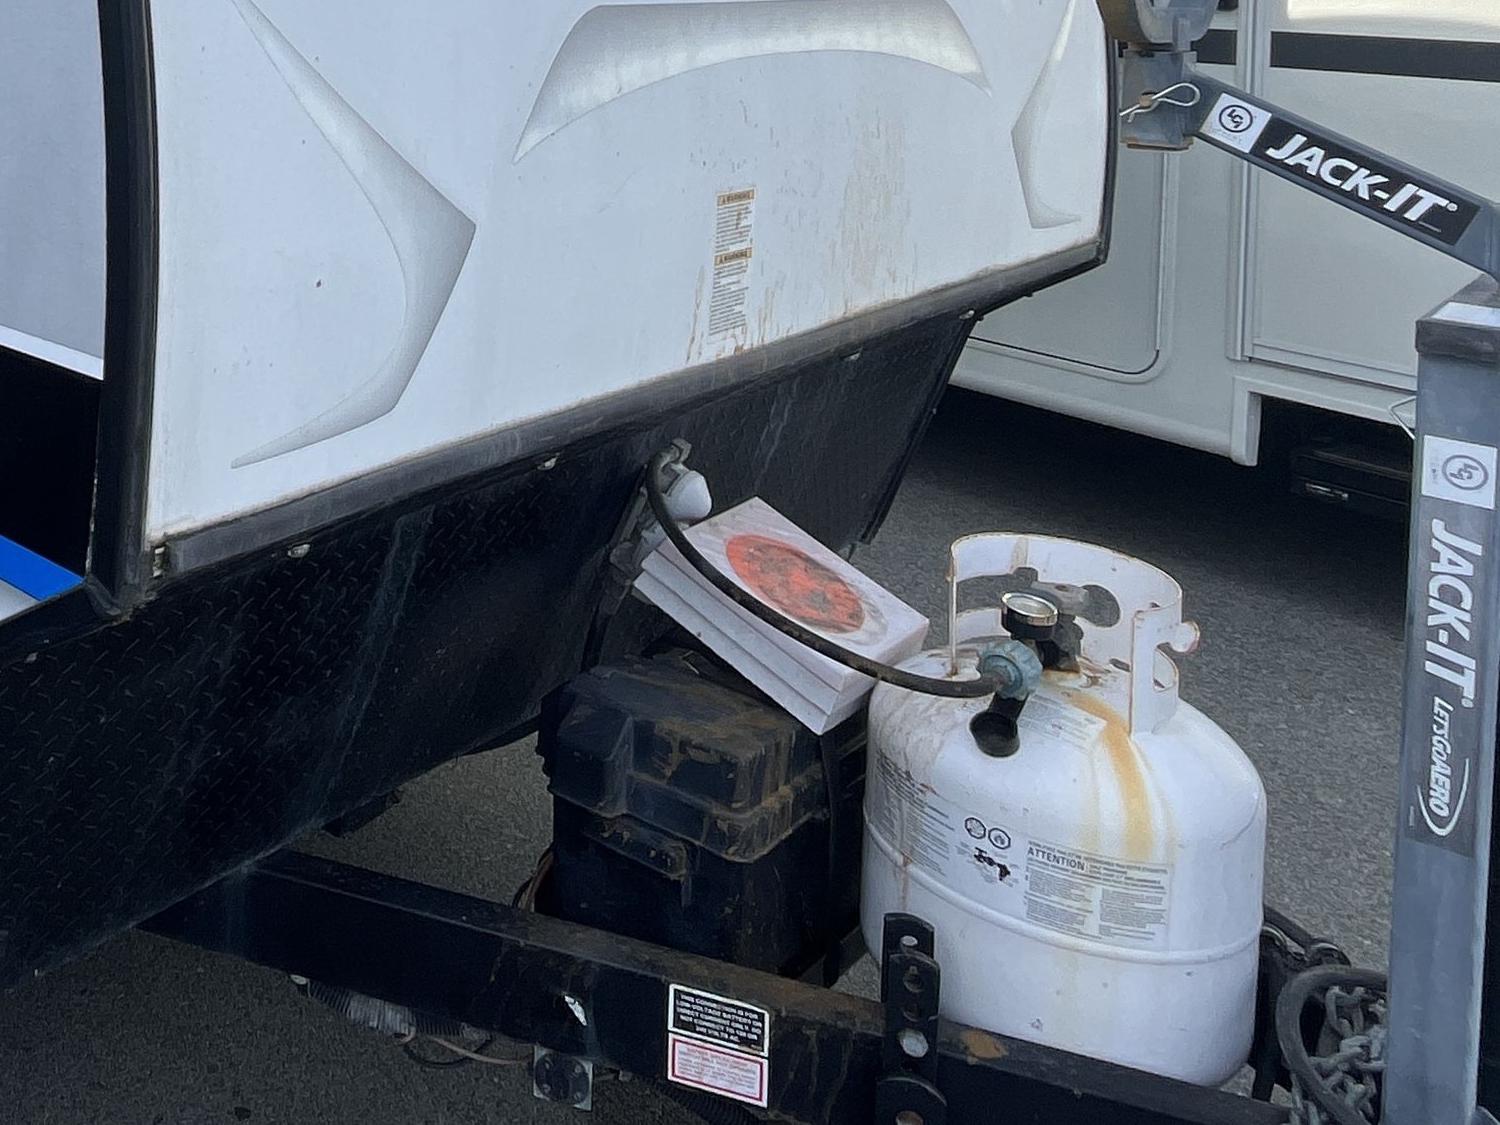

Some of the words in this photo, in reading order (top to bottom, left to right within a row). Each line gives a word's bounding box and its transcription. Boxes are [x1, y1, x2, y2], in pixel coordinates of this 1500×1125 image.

[1265, 133, 1451, 222] JACK-IT
[1425, 518, 1483, 698] JACK-IT
[1028, 846, 1085, 871] ATTENTION
